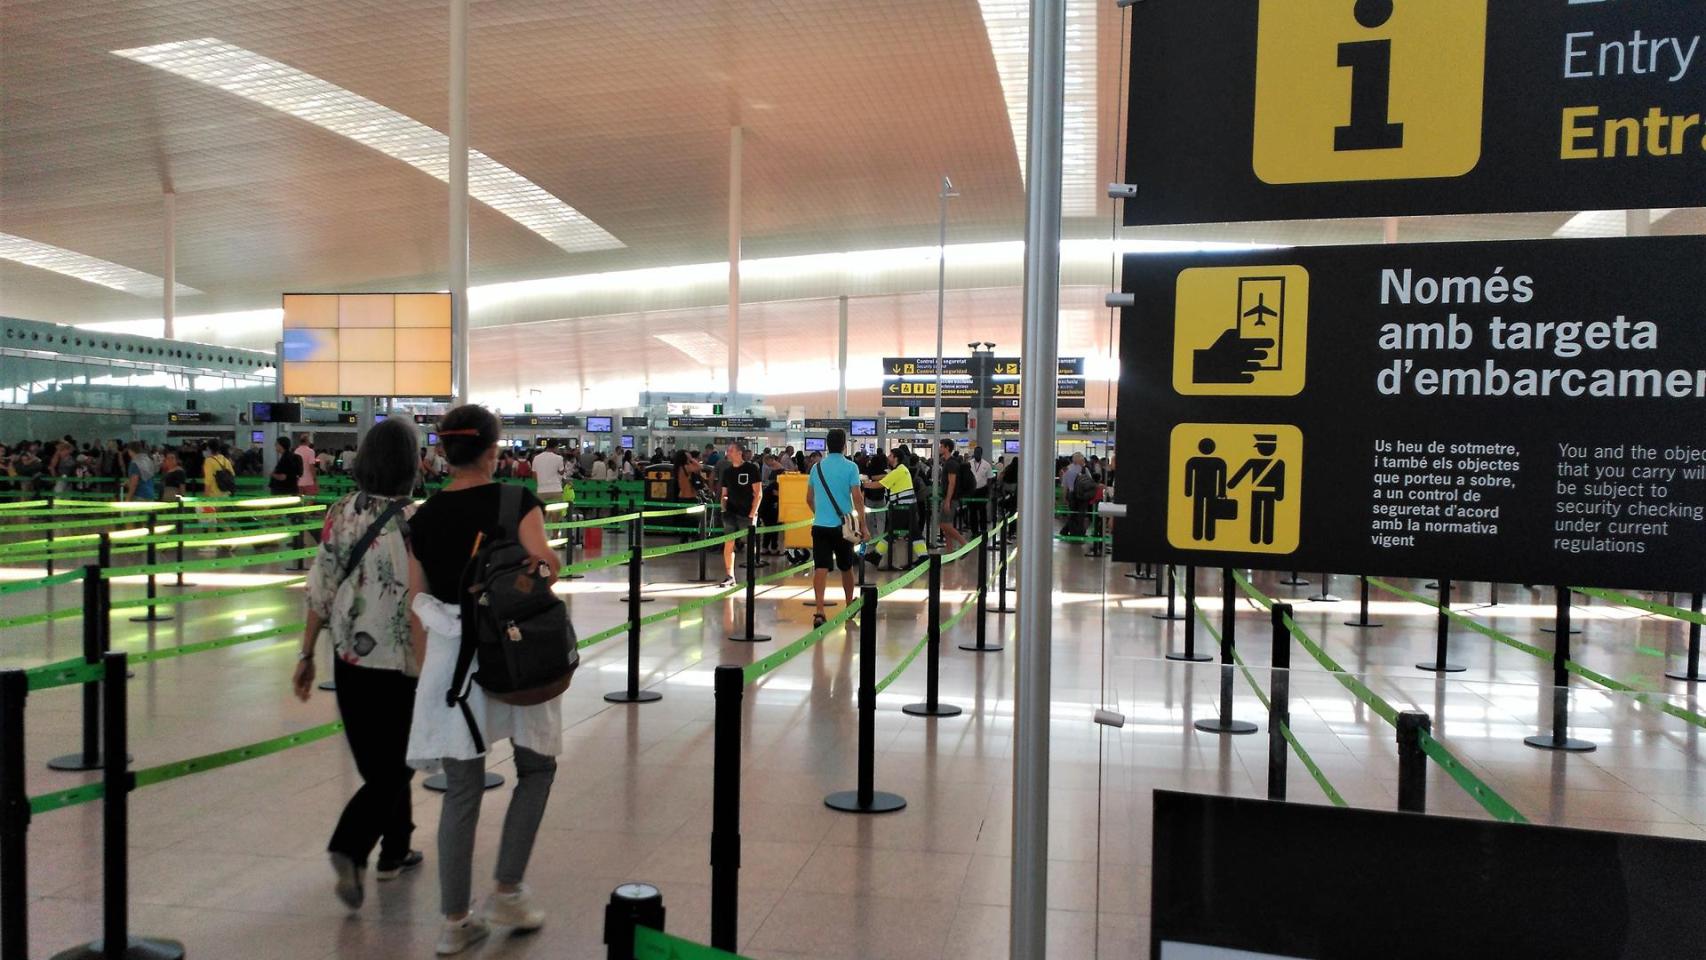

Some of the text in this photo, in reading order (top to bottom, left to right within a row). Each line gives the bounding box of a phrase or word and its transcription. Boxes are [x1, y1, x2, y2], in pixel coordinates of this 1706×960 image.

[1563, 30, 1701, 82] Entry
[1560, 106, 1706, 160] Entr
[1380, 266, 1534, 305] Només
[1378, 313, 1658, 358] amb targeta
[1376, 440, 1520, 456] Us heu de sotmetre,
[1559, 443, 1587, 458] You
[1594, 444, 1624, 459] and
[1631, 445, 1657, 460] the
[1374, 455, 1520, 472] i també els objectes
[1557, 462, 1590, 477] that
[1595, 465, 1624, 480] you
[1632, 467, 1676, 482] carry
[1374, 473, 1516, 488] que porteu a sobre,
[1373, 488, 1481, 502] a un control de
[1557, 480, 1668, 499] be subject to
[1372, 505, 1500, 519] seguretat d'acord
[1556, 499, 1705, 520] security checking
[1372, 519, 1498, 535] amb la normativa
[1555, 518, 1669, 535] under current
[1371, 533, 1415, 547] vigent
[1554, 537, 1645, 553] regulations
